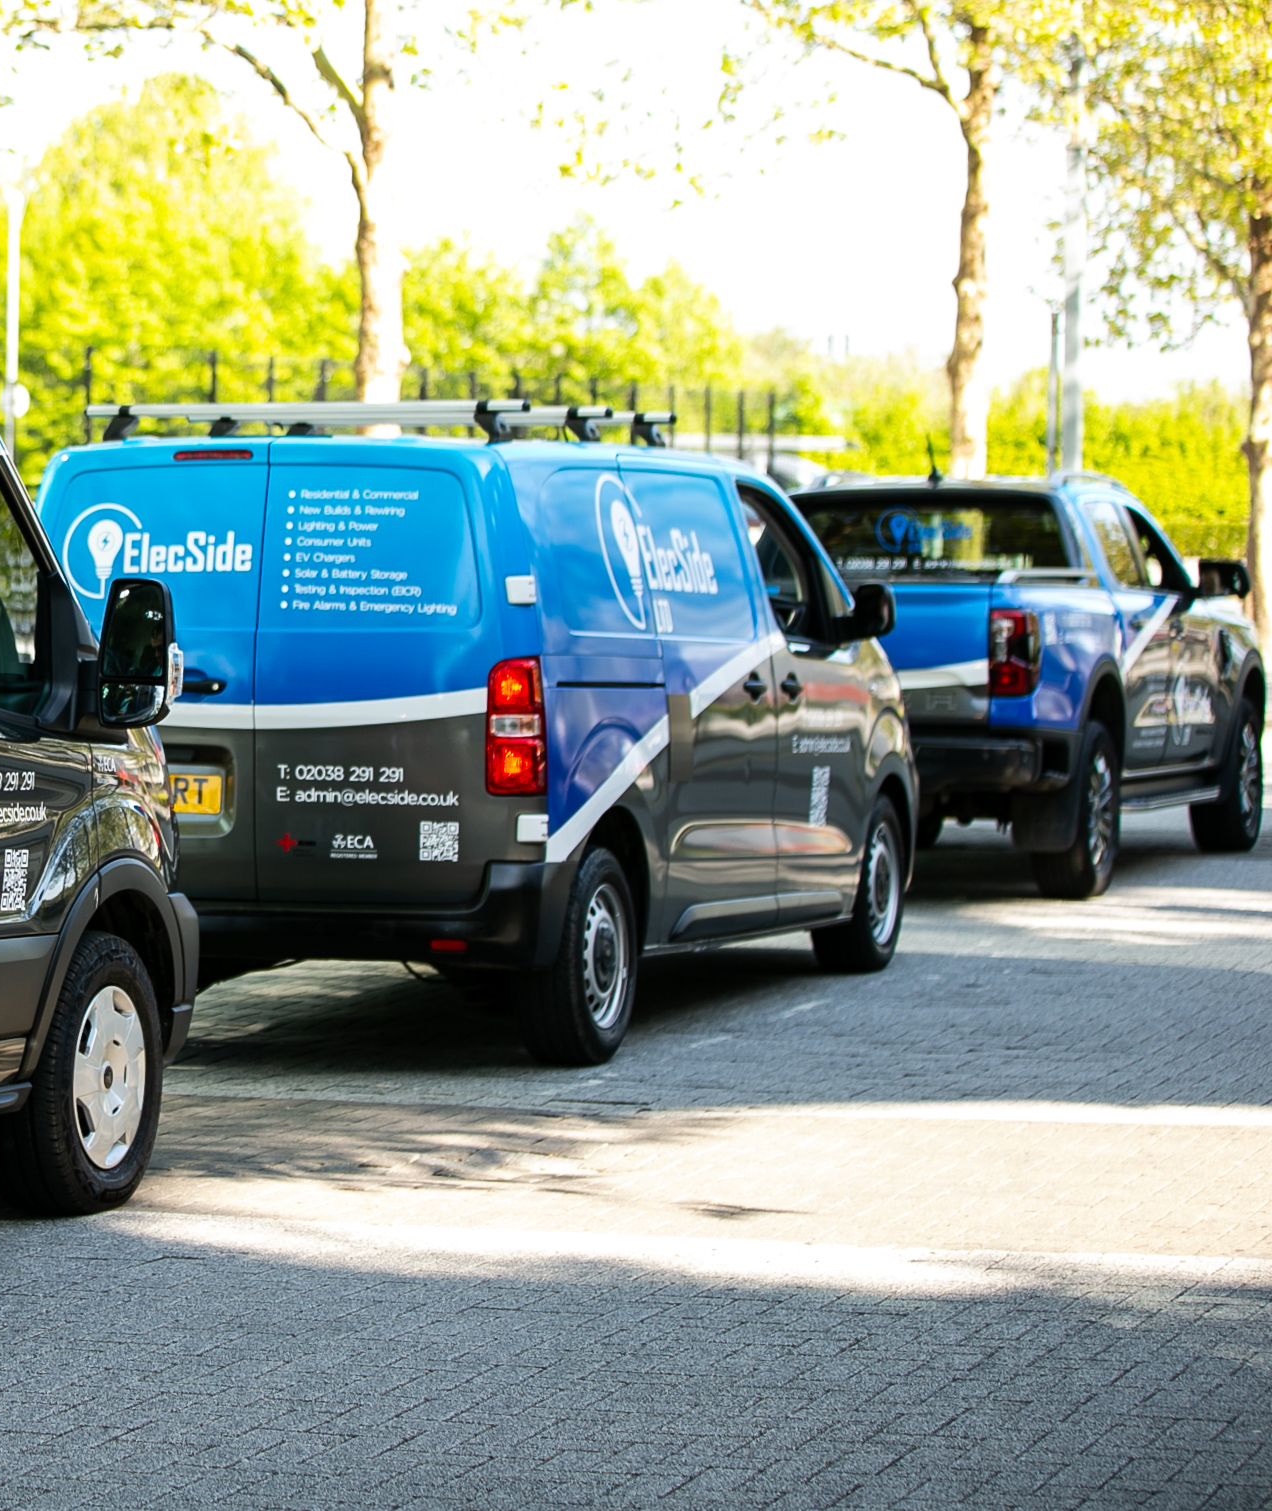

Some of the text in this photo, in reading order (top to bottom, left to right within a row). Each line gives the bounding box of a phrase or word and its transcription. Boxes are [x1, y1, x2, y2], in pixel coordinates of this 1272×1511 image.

[300, 489, 419, 501] Residential & Commercial
[299, 505, 406, 518] New Builds & Rewiring
[298, 521, 378, 532] Lighting & Power
[296, 536, 372, 548] Consumer Units
[122, 530, 253, 574] ElecSide
[295, 552, 355, 564] EV Chargers
[636, 524, 719, 595] ElecSide
[294, 568, 408, 582] Solar & Battery Storage
[294, 583, 422, 598] Testing & Inspection (EICR)
[292, 600, 458, 616] Fire Alarms & Emergency Lighting
[277, 764, 404, 783] T: 02038 291 291
[3, 771, 19, 791] 291
[20, 771, 35, 791] 291
[276, 786, 460, 807] E: admin@elecside.co.uk
[347, 835, 374, 849] ECA
